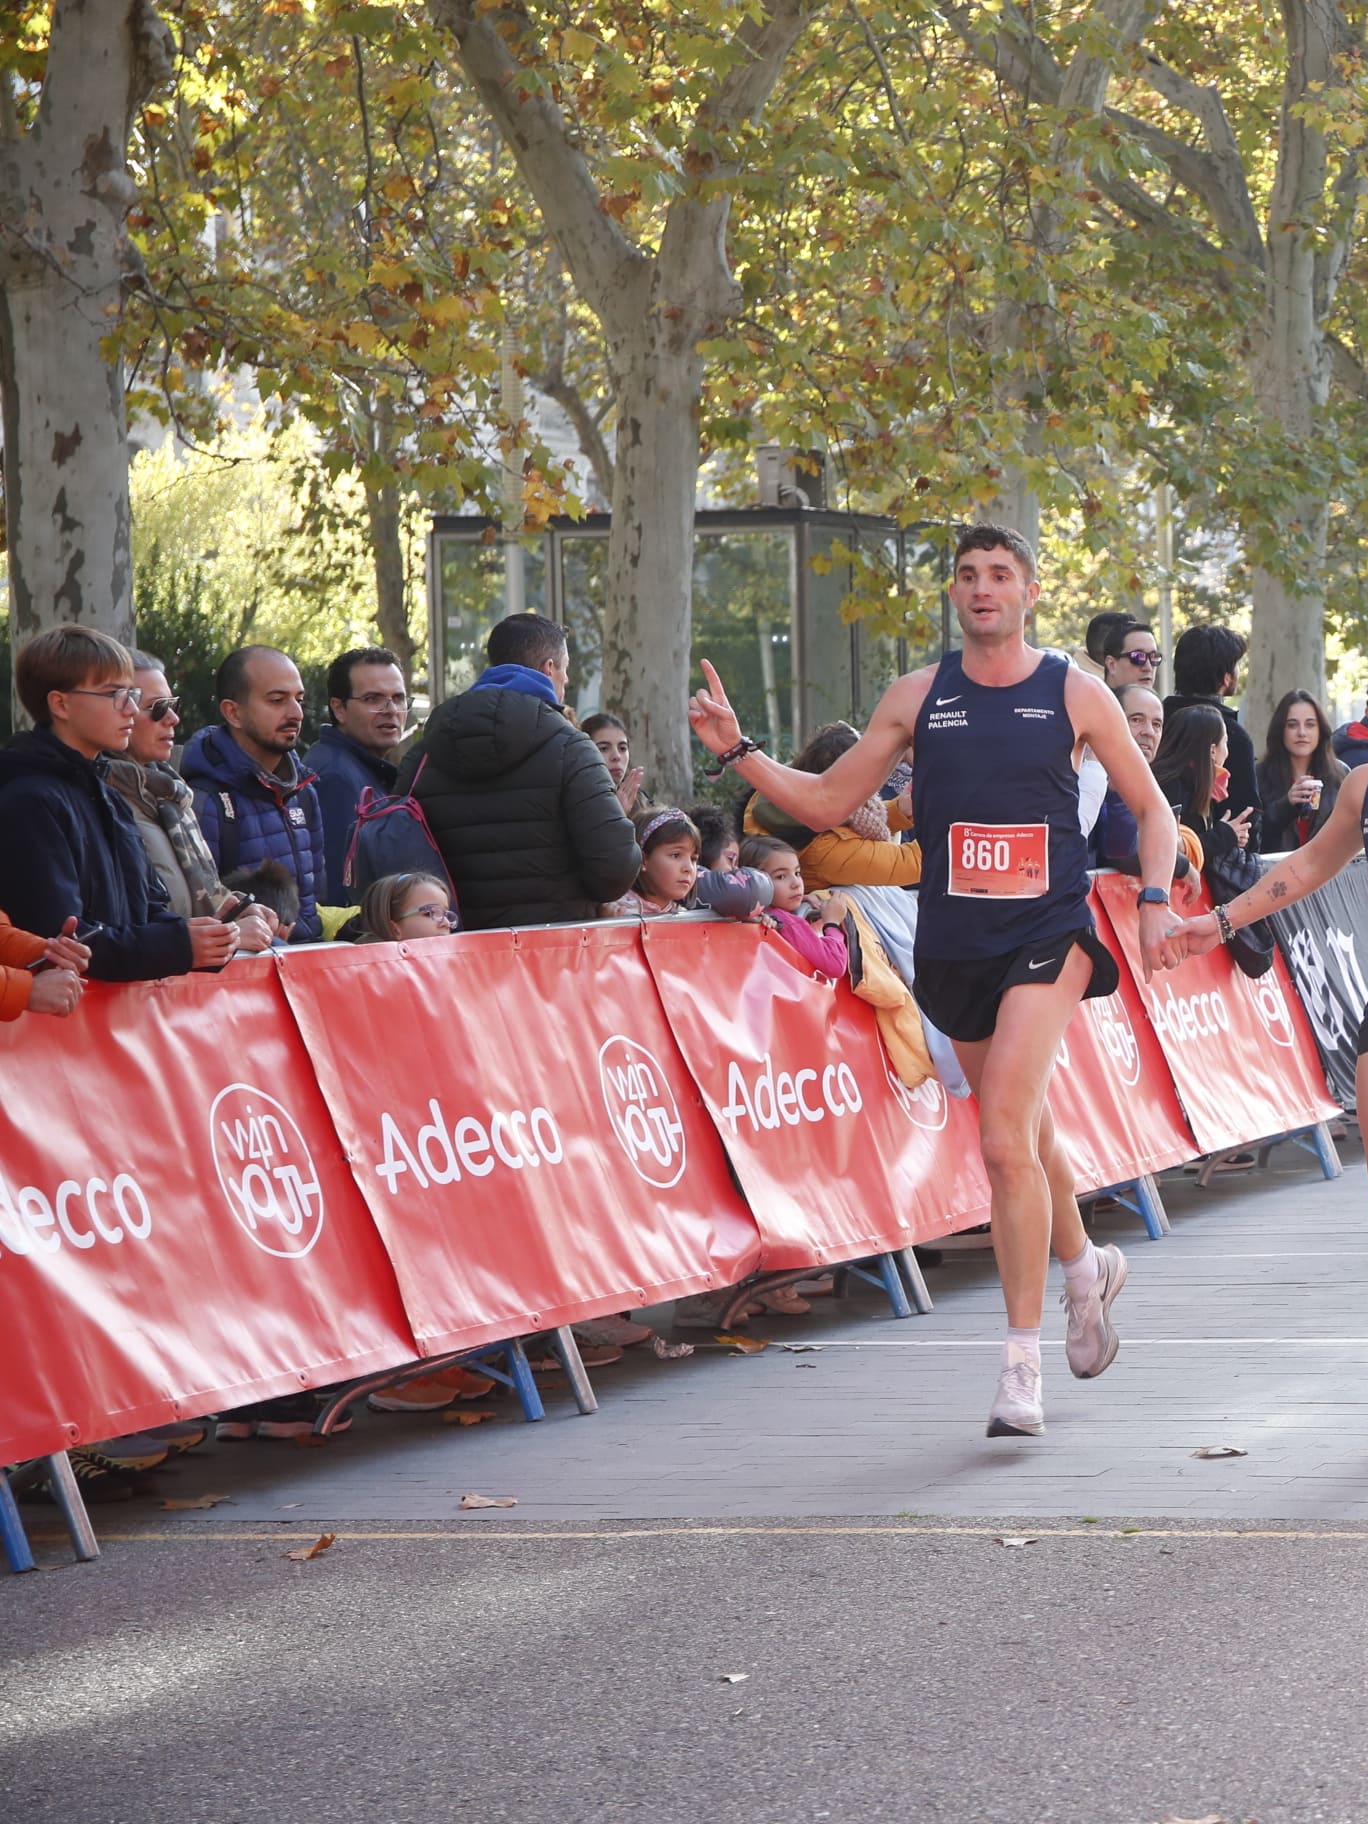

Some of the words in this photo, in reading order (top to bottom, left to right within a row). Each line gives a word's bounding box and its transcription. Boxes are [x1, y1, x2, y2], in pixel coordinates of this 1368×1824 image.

[928, 719, 968, 730] PALENCIA
[929, 710, 967, 721] RENAULT
[1014, 708, 1054, 716] DEPARTAMENTO
[961, 838, 1010, 871] 860
[1150, 982, 1229, 1044] Adecco
[722, 1053, 862, 1135] Adecco
[376, 1098, 563, 1194] Adecco
